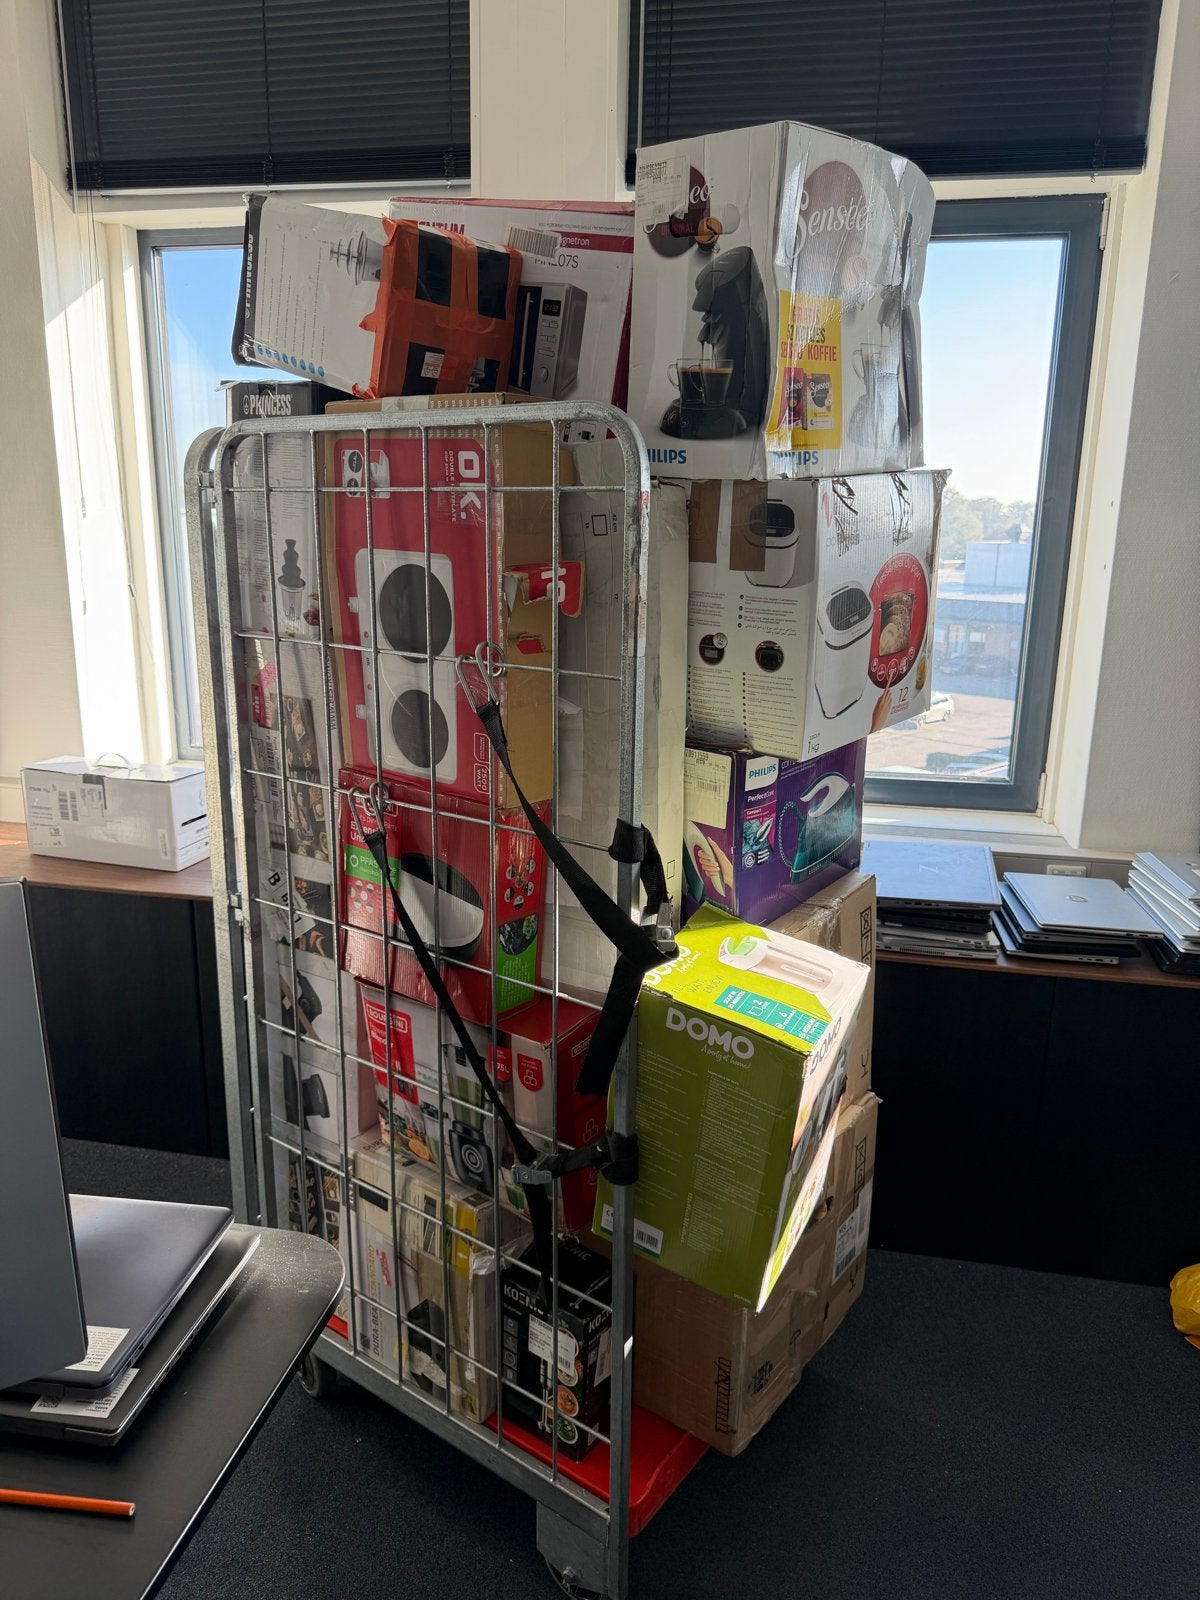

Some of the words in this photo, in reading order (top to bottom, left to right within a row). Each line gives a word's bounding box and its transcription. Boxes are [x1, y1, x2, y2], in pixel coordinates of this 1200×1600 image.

[560, 237, 590, 246] gnetron
[808, 345, 837, 361] KOFFIE
[647, 448, 687, 465] ILIPS
[898, 686, 909, 702] 12
[748, 764, 777, 779] PHILIPS
[642, 945, 691, 986] DOO
[368, 1008, 404, 1029] BOURINI
[665, 1007, 755, 1060] DOMO
[372, 1306, 381, 1355] DURA-BEA
[588, 1310, 609, 1333] KOE
